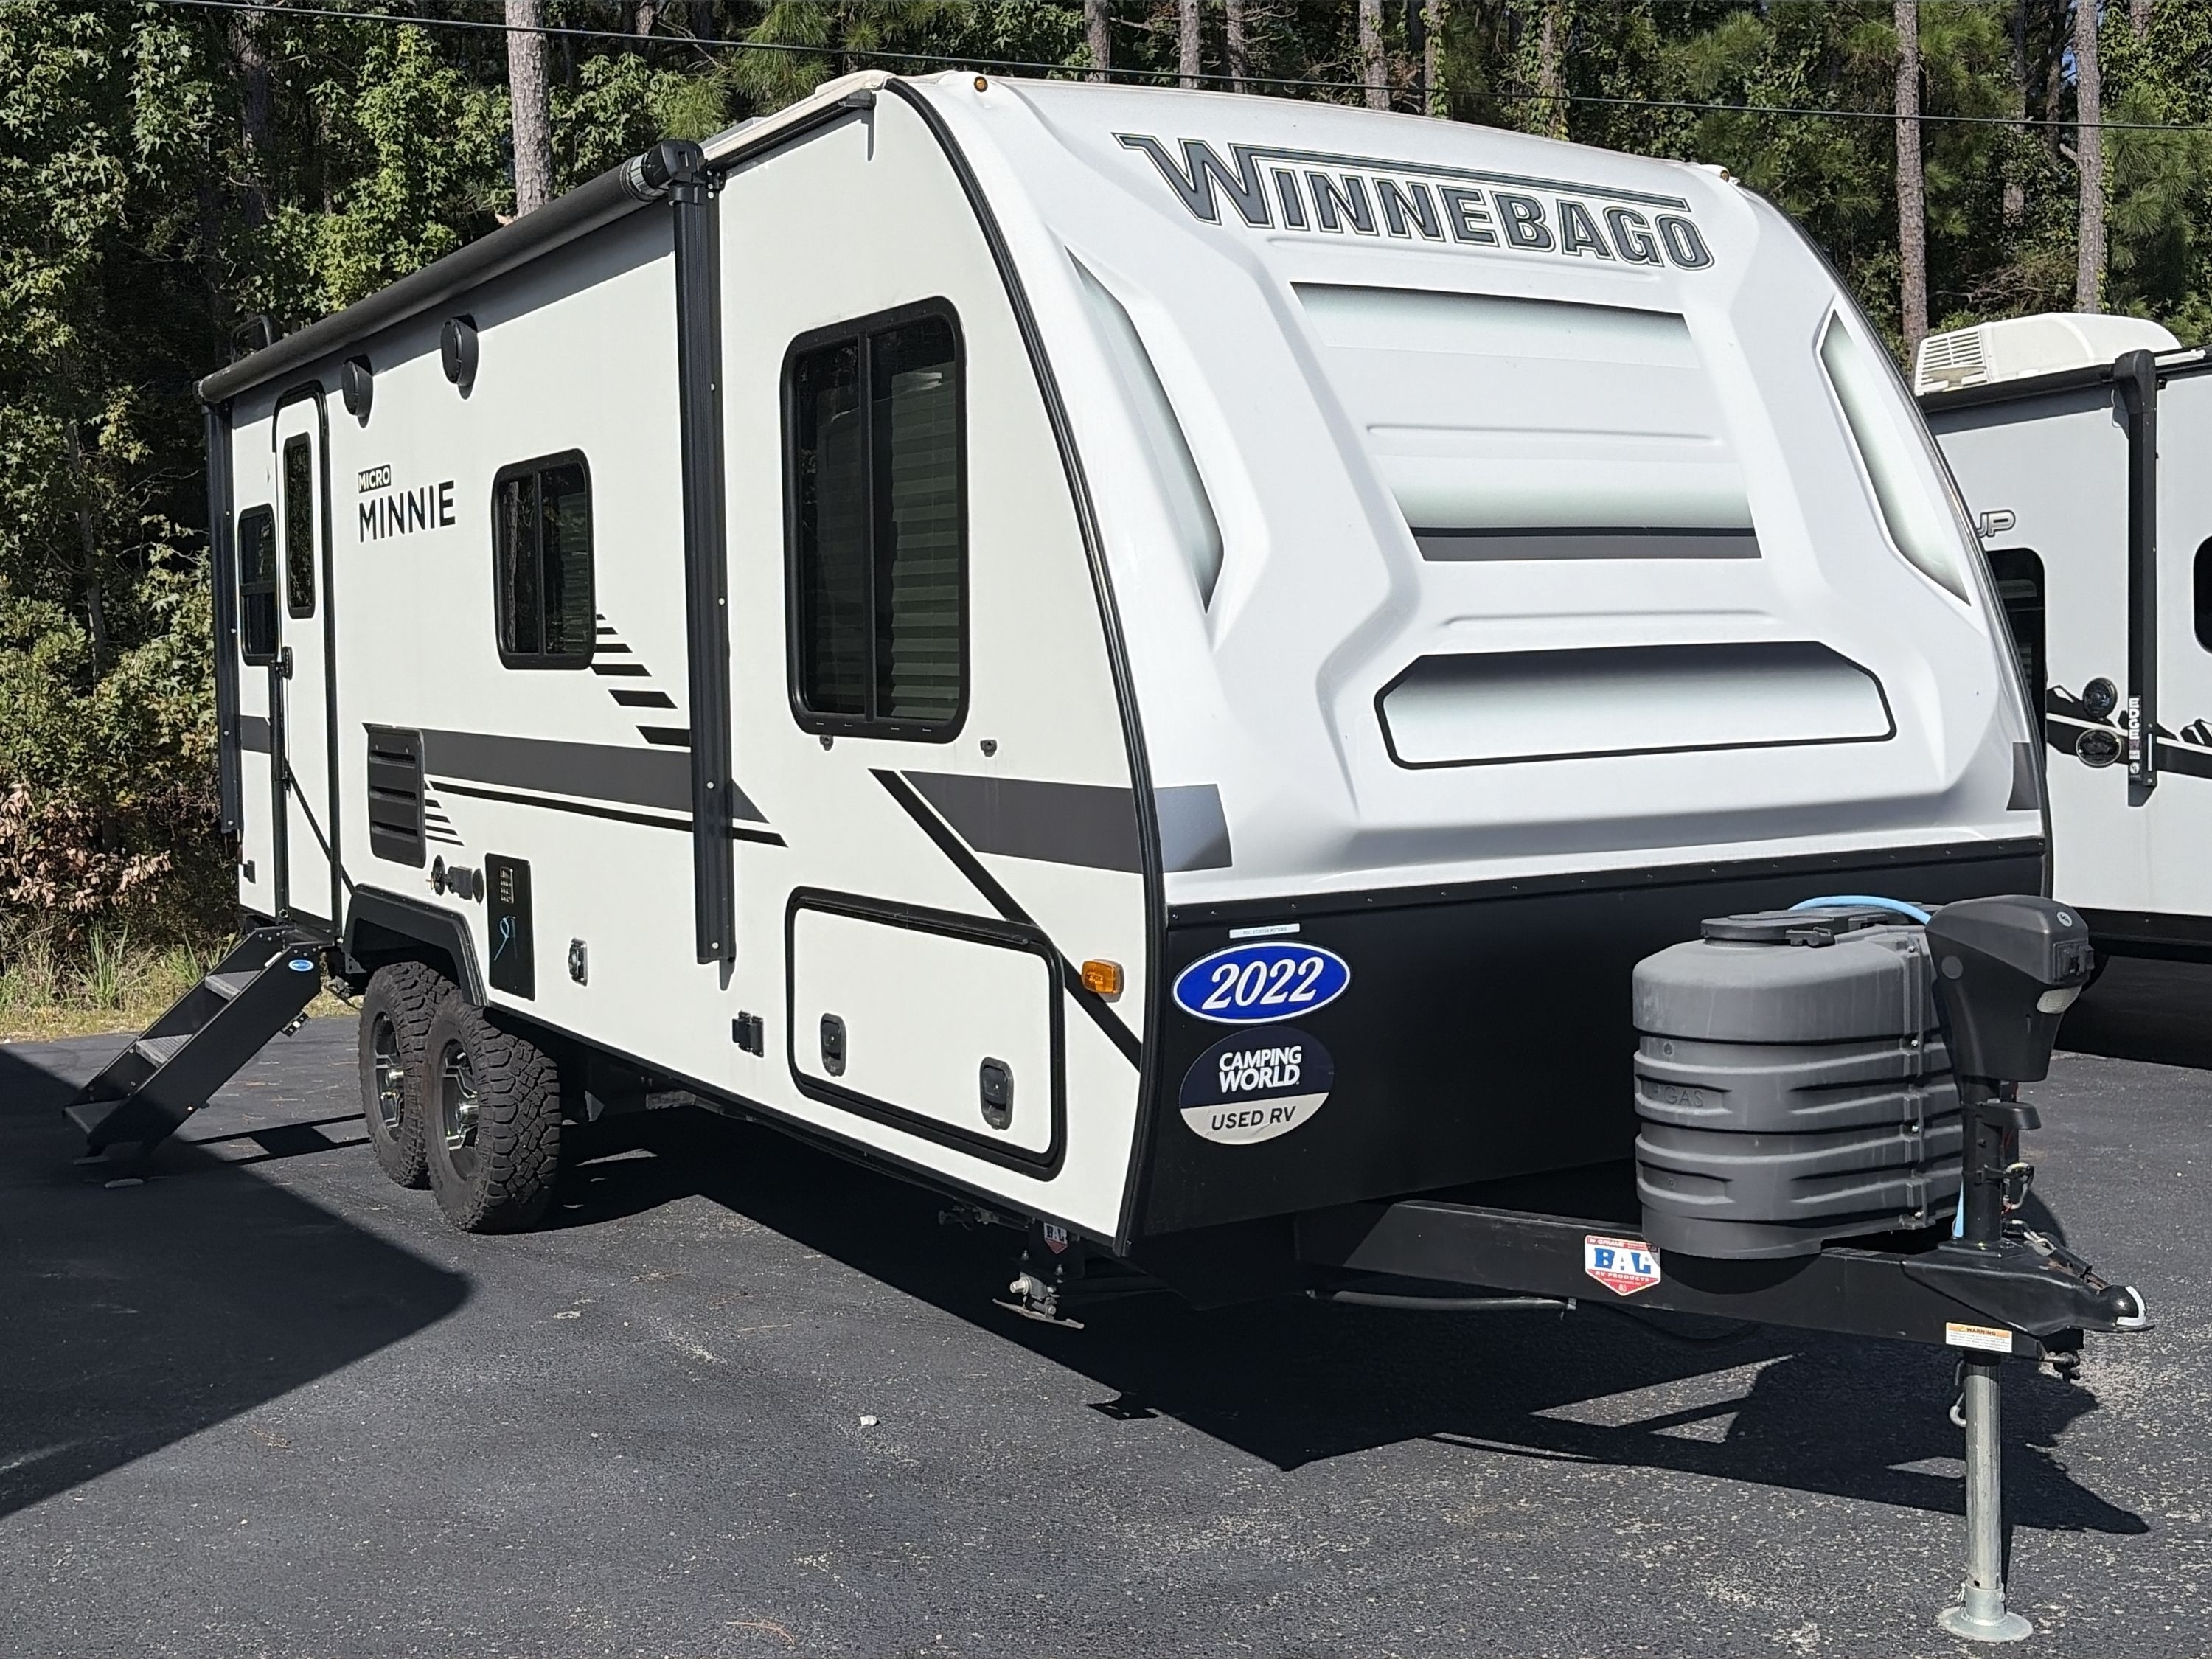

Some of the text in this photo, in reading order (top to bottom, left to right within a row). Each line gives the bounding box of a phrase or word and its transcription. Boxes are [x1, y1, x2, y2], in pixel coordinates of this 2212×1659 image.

[1111, 133, 1714, 271] WINNEBAGO
[358, 467, 391, 492] MICRO
[359, 480, 456, 543] MINNIE
[2129, 698, 2140, 740] EDGE
[1201, 956, 1324, 1010] 2022
[1219, 1046, 1302, 1071] CAMPING
[1219, 1065, 1300, 1093] WORLD
[1663, 1086, 1703, 1108] GAS
[1211, 1106, 1296, 1131] USED RV
[1594, 1247, 1652, 1275] BAL
[1607, 1272, 1650, 1282] PRODUCTS
[1966, 1327, 1997, 1336] WARNING
